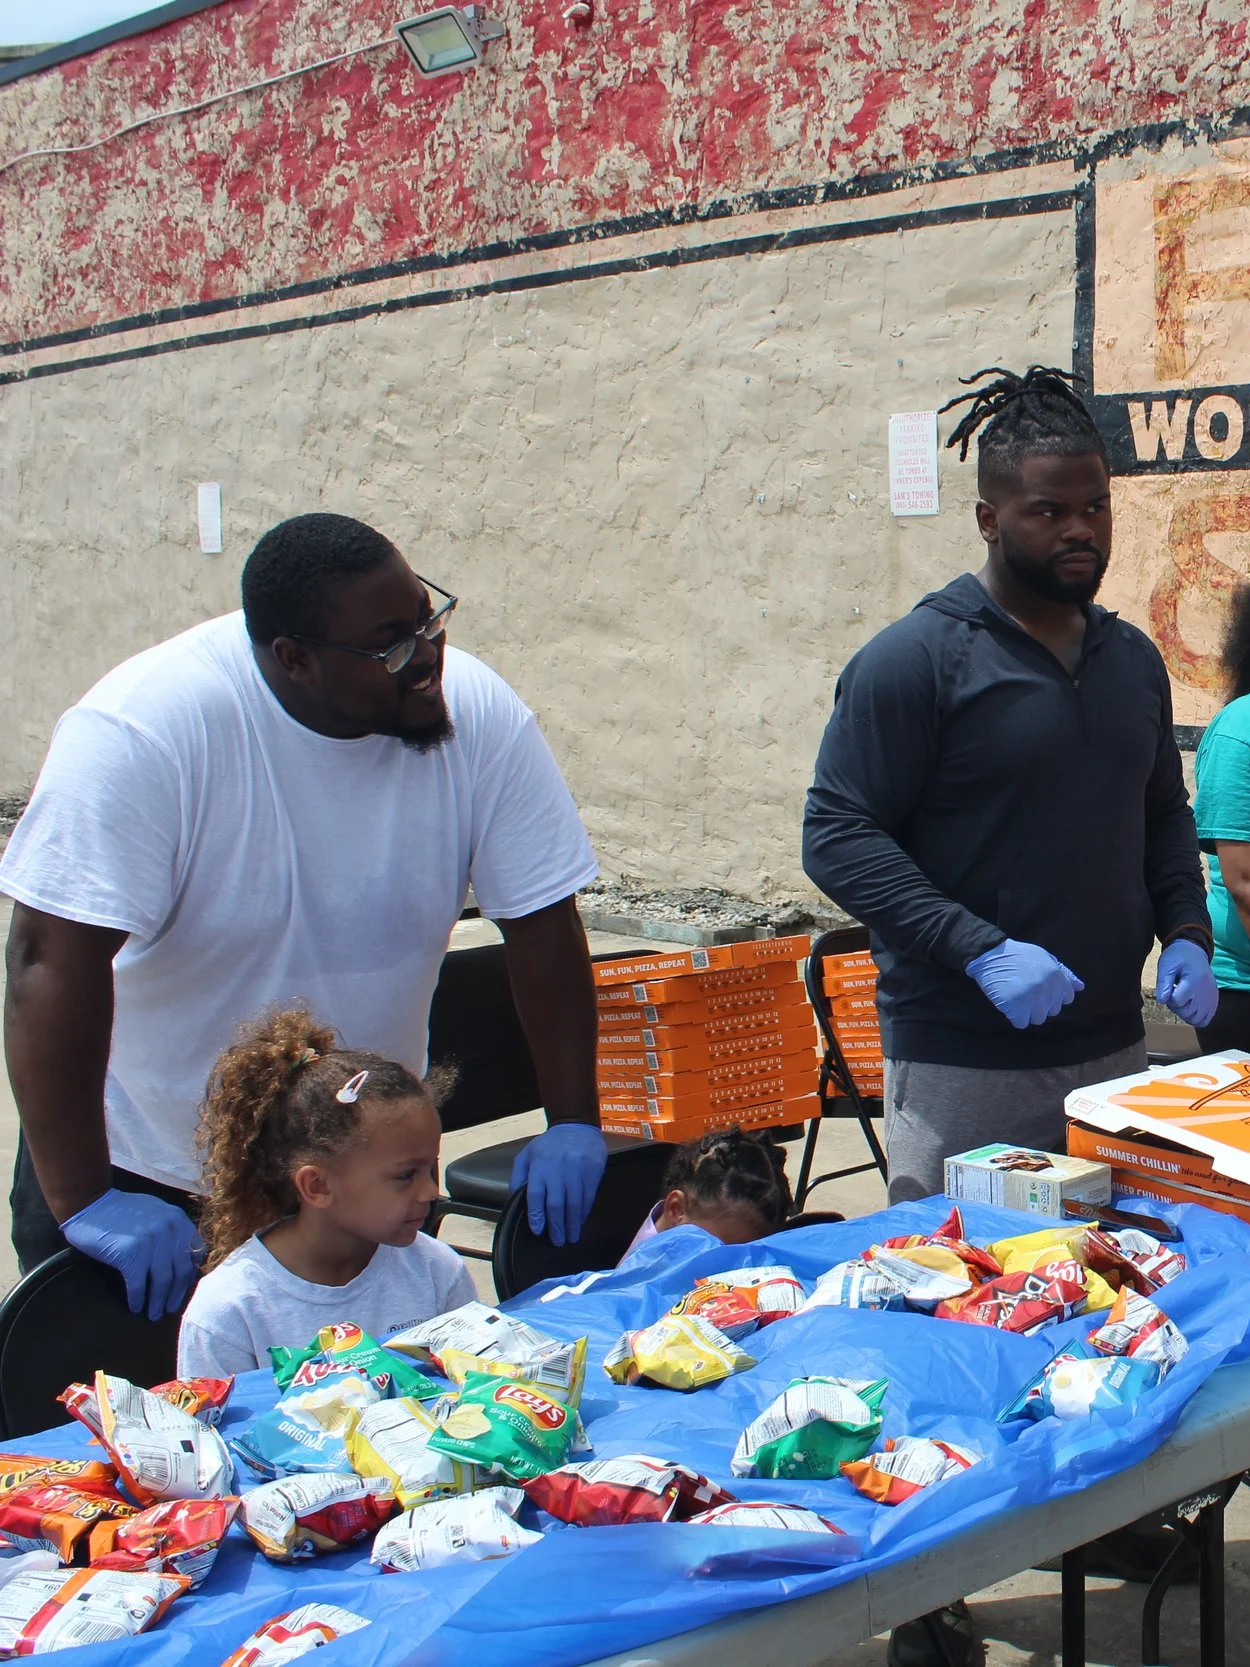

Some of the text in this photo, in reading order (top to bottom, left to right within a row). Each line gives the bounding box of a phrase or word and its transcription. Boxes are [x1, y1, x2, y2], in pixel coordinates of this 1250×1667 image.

[894, 490, 935, 500] SAM'S TOWING
[659, 959, 686, 969] REPEAT
[1095, 1145, 1139, 1165] SUMMER
[1140, 1157, 1181, 1174] CHILLIN'
[1110, 1180, 1134, 1195] MMER
[1045, 1259, 1083, 1285] Lay
[350, 1346, 381, 1359] Cream
[502, 1386, 563, 1422] Lay's
[489, 1407, 517, 1418] Sour
[278, 1421, 328, 1450] ORIGINAL
[456, 1439, 477, 1449] CHIPS
